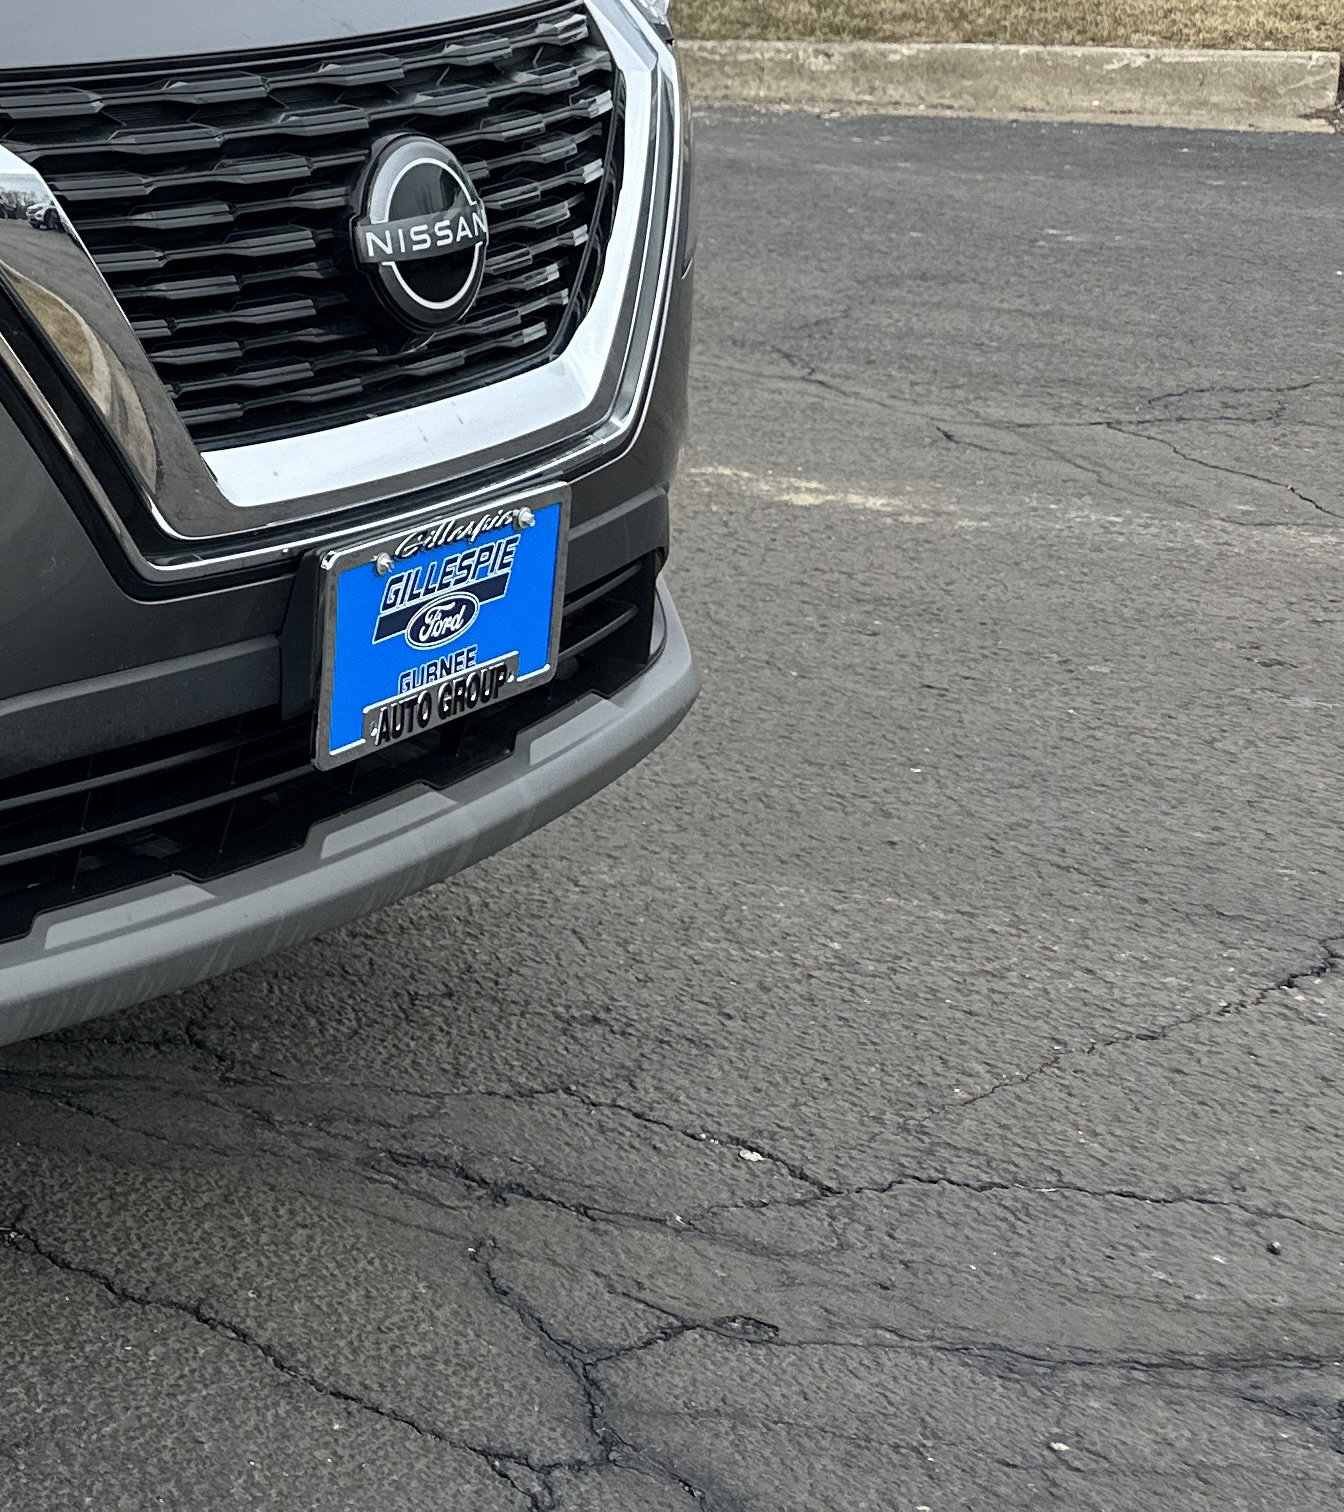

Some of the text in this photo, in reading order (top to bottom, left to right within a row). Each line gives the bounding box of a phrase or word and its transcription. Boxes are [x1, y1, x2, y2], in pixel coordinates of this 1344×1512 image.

[365, 210, 487, 257] NISSAN
[379, 533, 521, 615] GILLESPIE
[418, 603, 466, 643] Ford
[398, 643, 479, 695] GURNEE
[375, 661, 508, 746] AUTO GROUP
